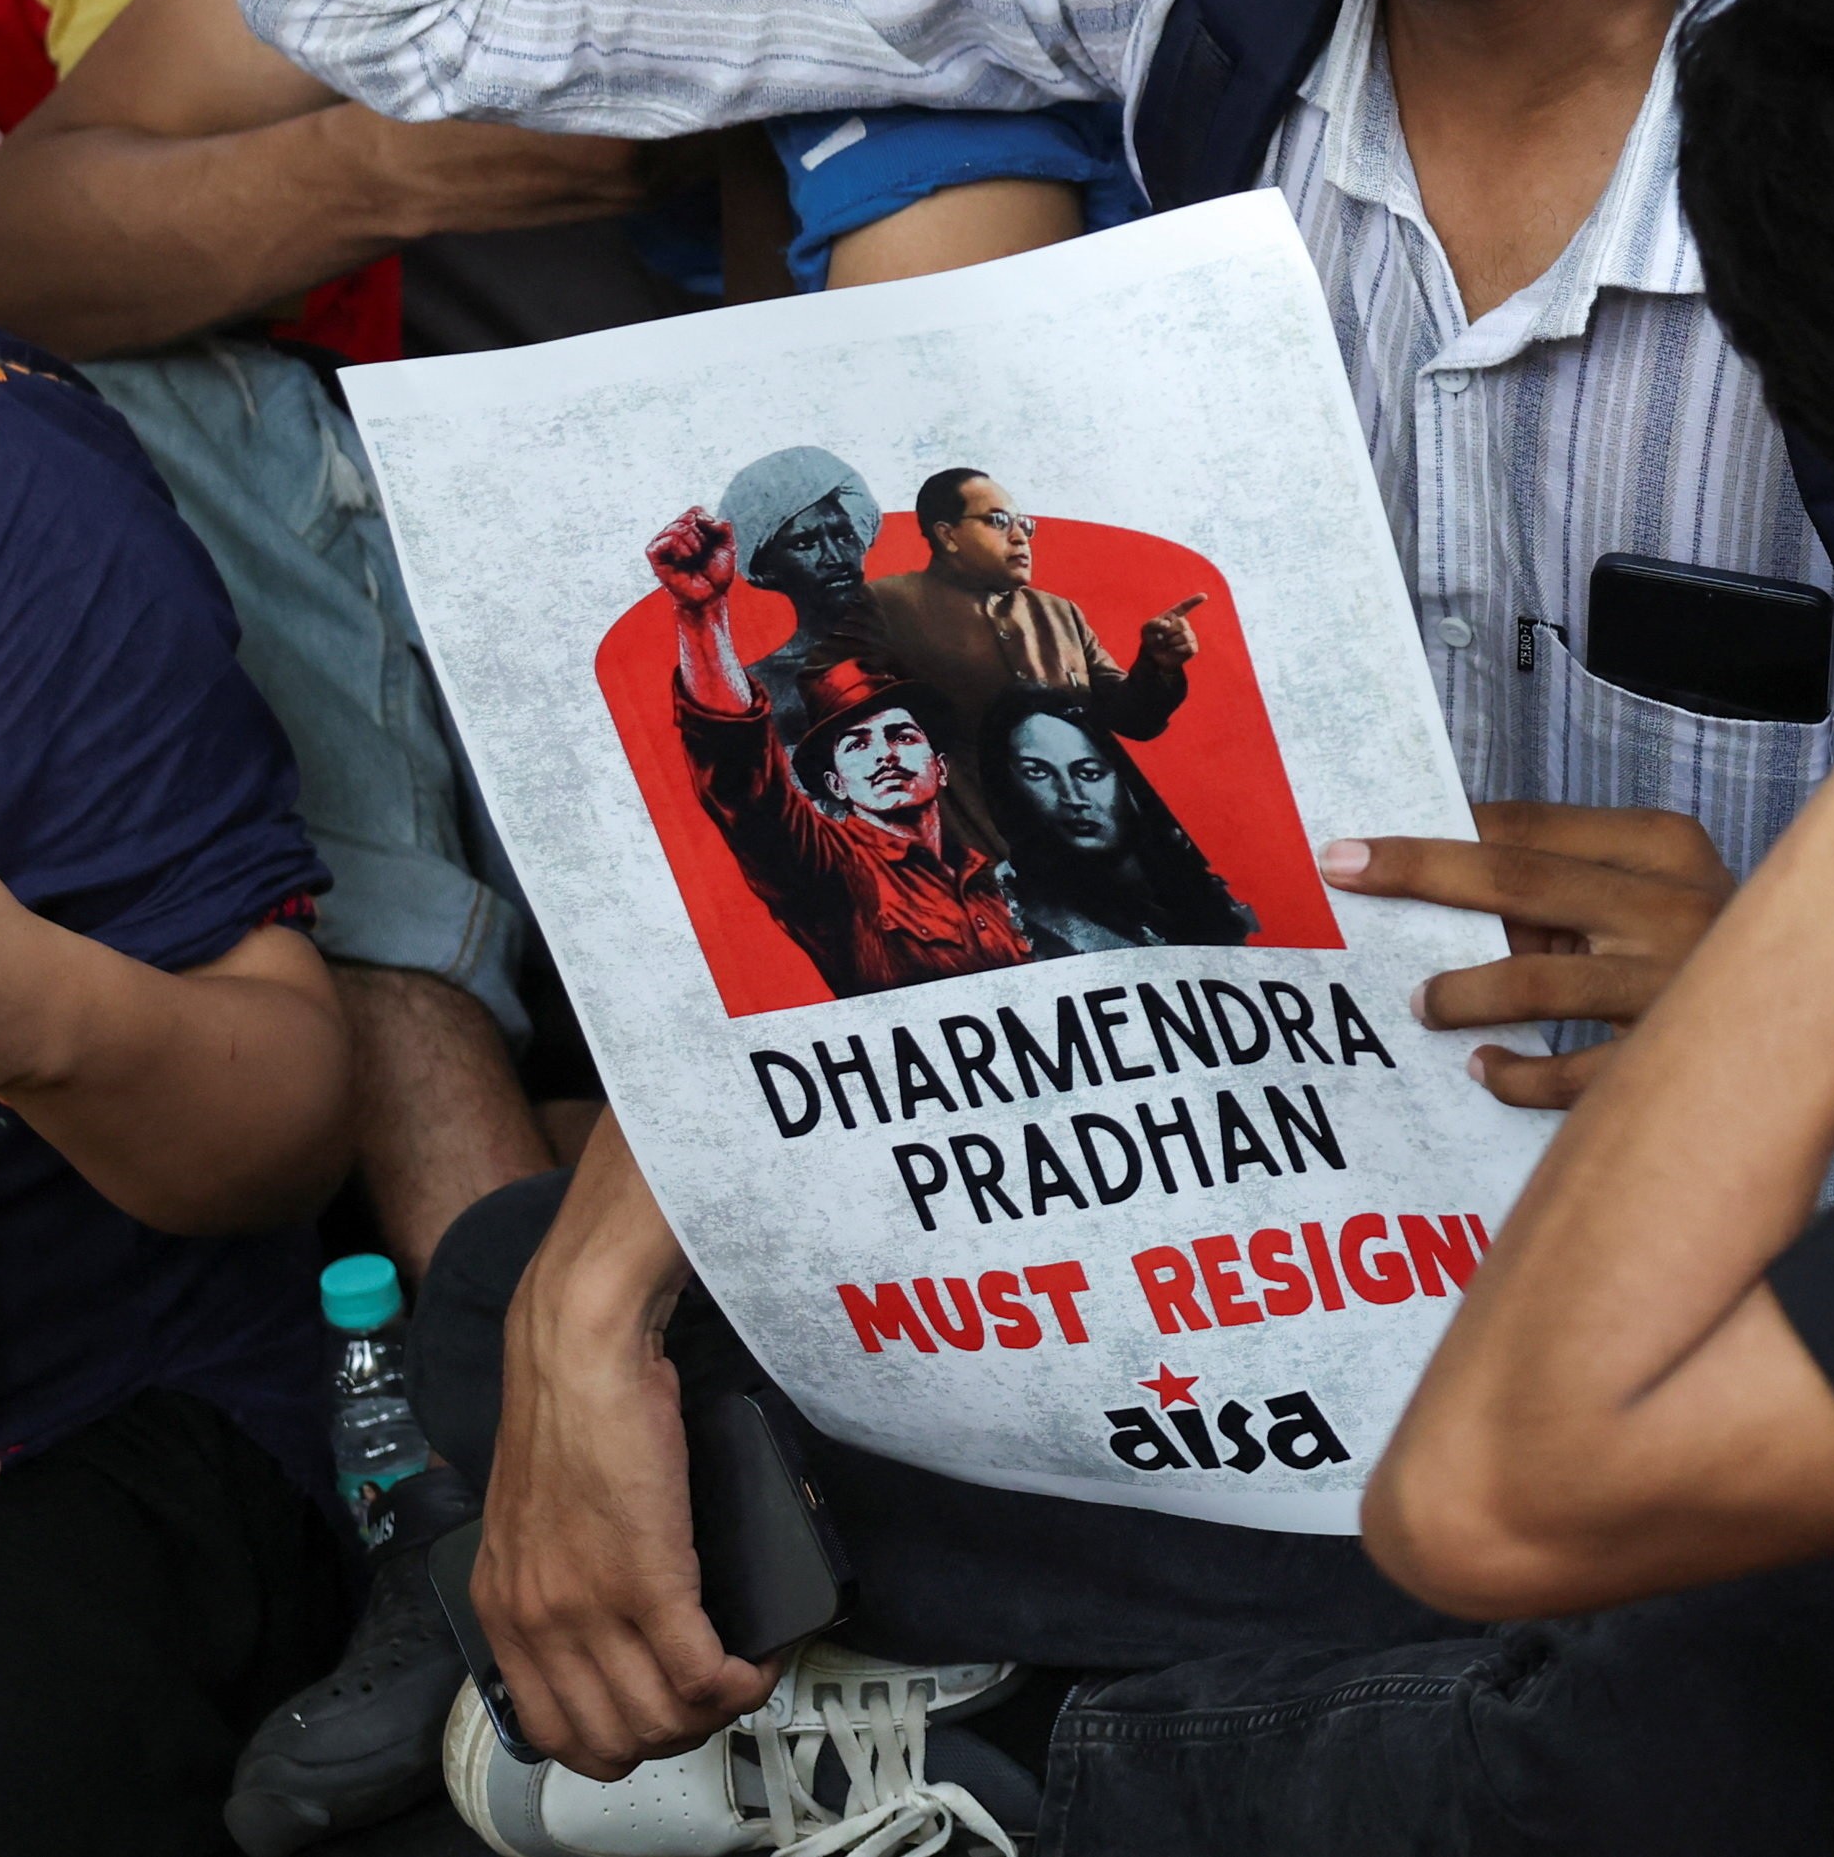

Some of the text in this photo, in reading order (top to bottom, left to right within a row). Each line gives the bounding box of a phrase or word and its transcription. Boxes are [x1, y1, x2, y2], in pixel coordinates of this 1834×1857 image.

[749, 978, 1397, 1140] DHARMENDRA
[891, 1084, 1348, 1232] PRADHAN
[836, 1259, 1091, 1354] MUST
[1103, 1376, 1352, 1475] aisa
